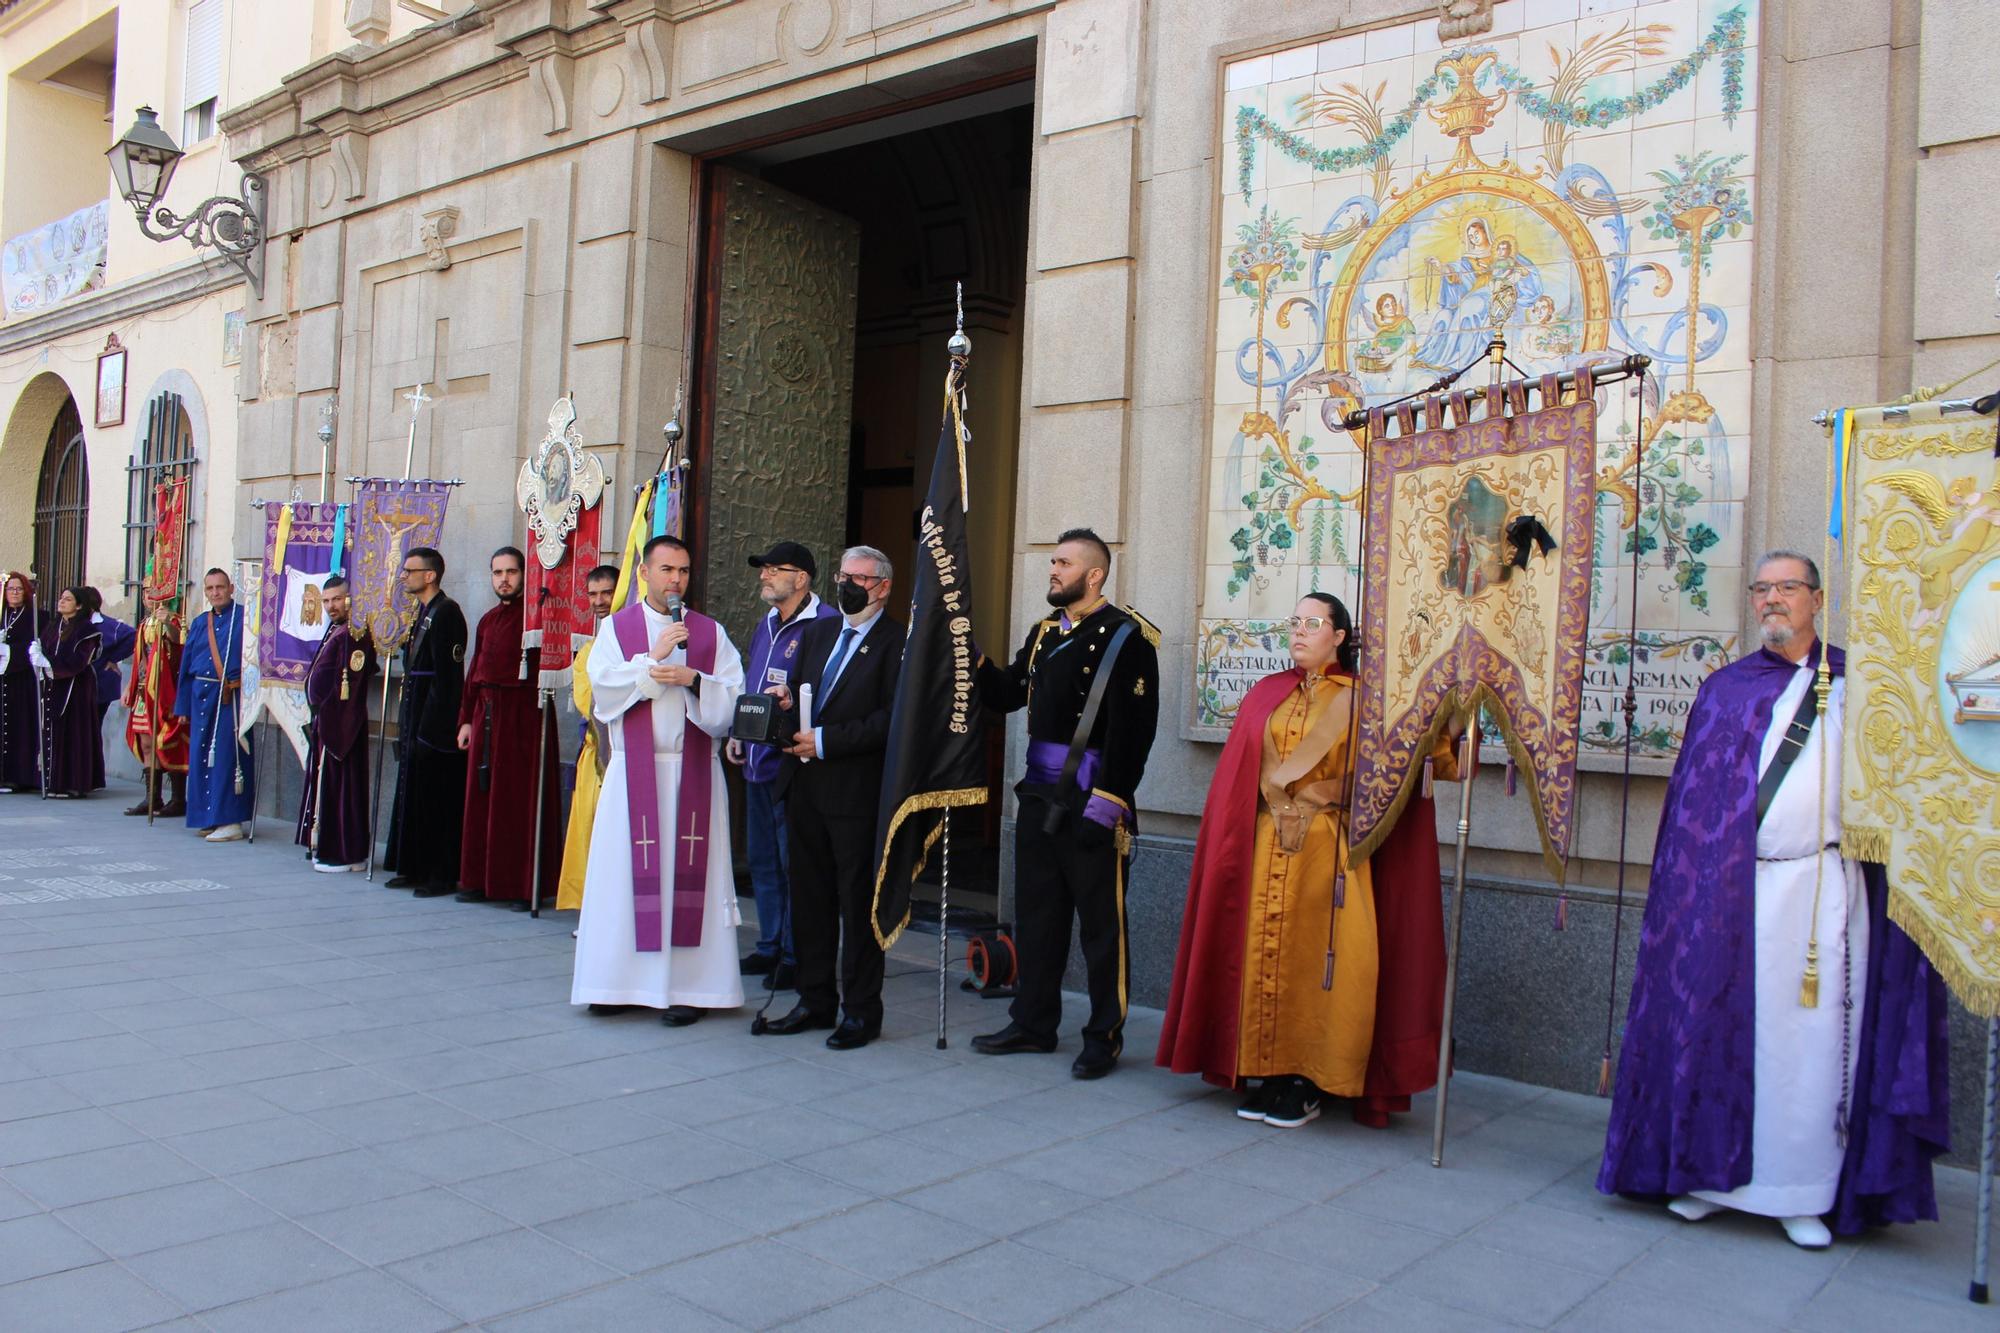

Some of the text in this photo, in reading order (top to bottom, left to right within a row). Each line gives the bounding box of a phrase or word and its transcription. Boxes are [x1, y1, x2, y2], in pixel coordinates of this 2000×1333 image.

[943, 590, 961, 612] de
[949, 616, 974, 734] Granaderos
[739, 704, 765, 714] MIPRO
